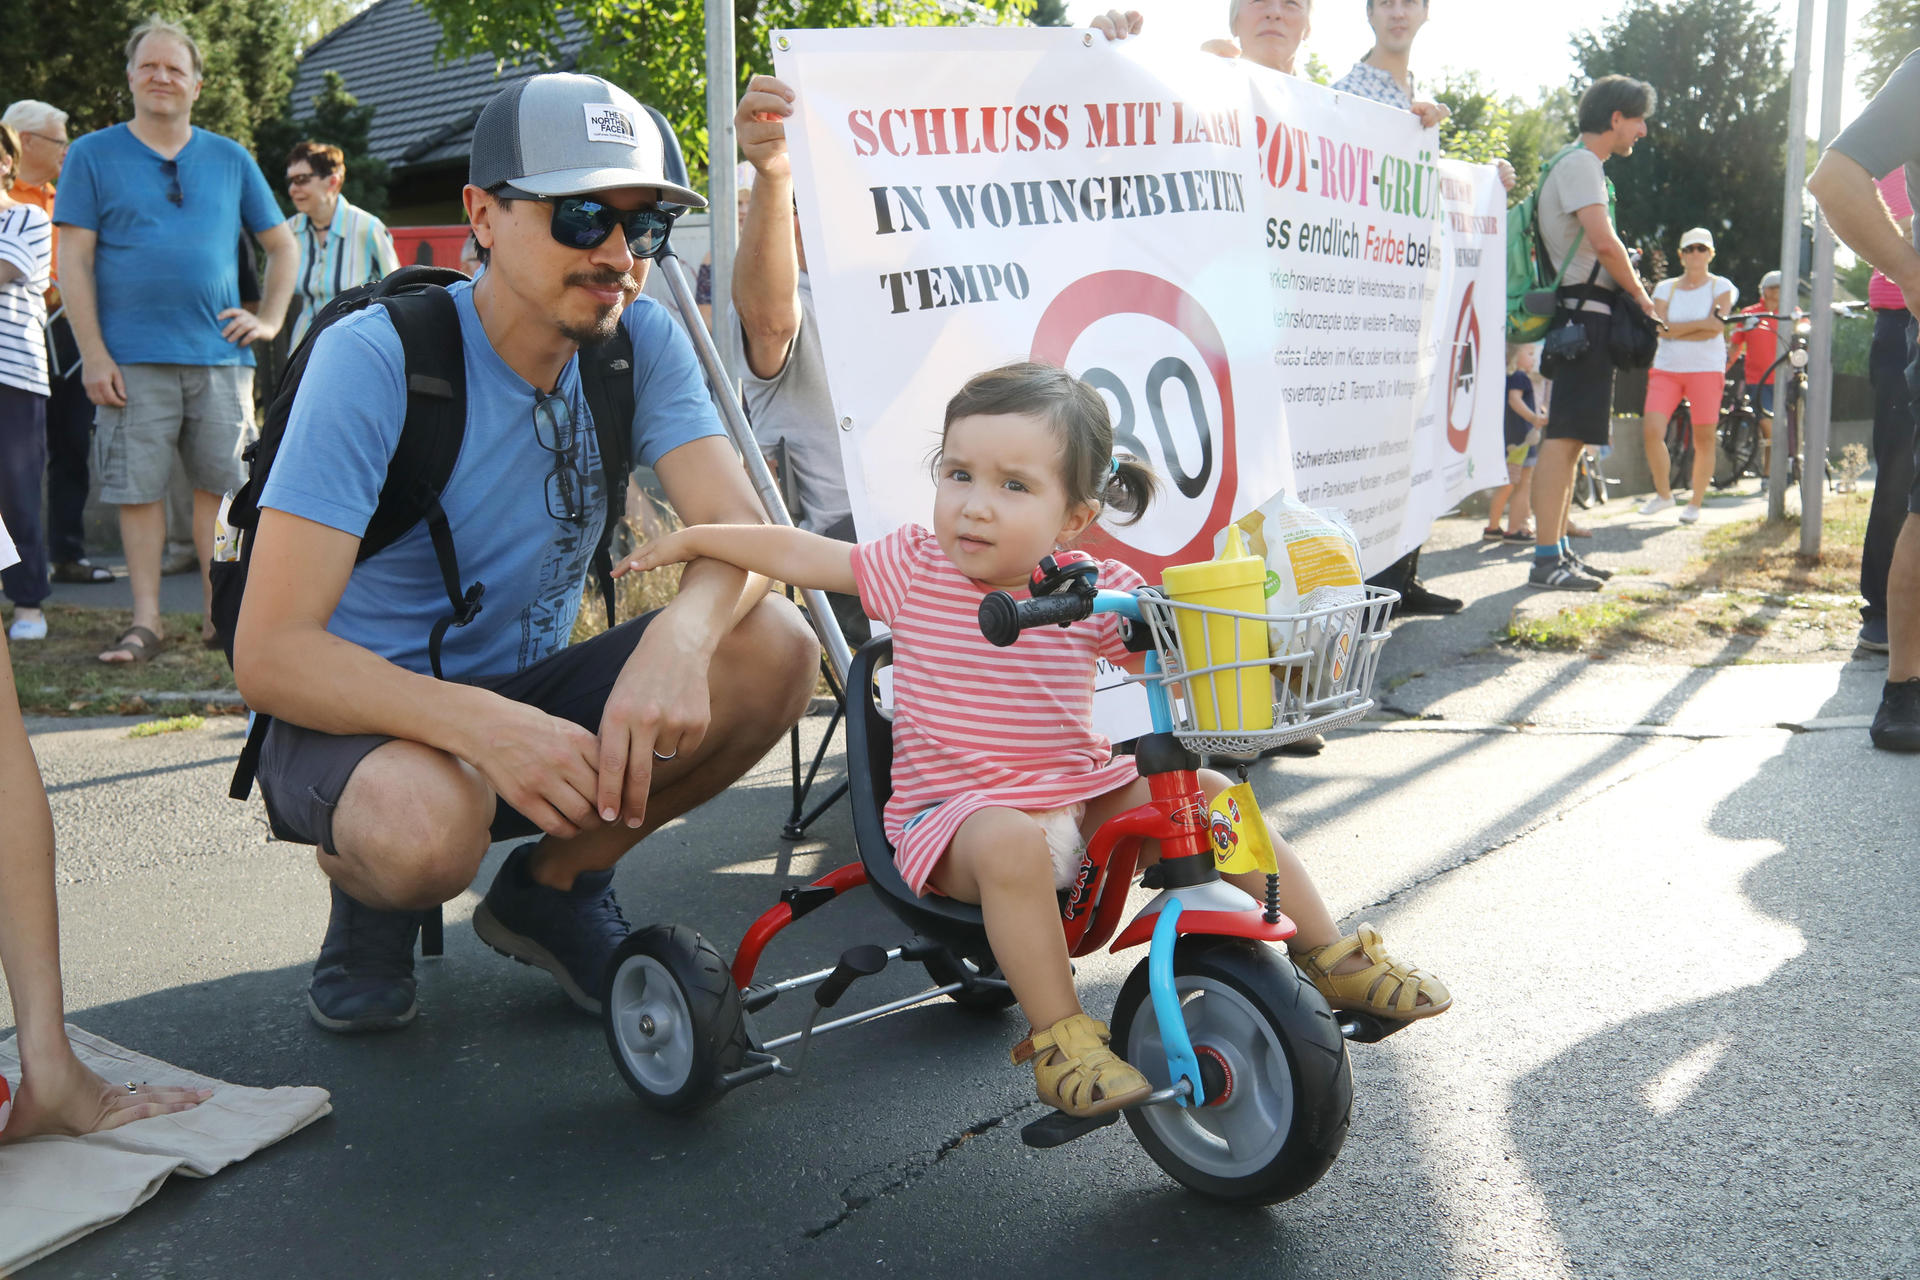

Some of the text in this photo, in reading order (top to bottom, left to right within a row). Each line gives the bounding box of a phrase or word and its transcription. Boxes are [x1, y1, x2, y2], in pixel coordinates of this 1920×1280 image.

[591, 117, 621, 126] NORTH
[603, 110, 620, 119] THE
[601, 125, 622, 133] FACE
[848, 104, 1069, 156] SCHLUSS
[1084, 102, 1161, 148] MIT
[869, 170, 1245, 235] IN WOHNGEBIETEN
[1299, 217, 1359, 259] endlich
[1364, 225, 1404, 264] Farbe
[879, 262, 1030, 314] TEMPO
[1338, 274, 1355, 294] oder
[1343, 313, 1361, 330] oder
[1304, 345, 1333, 366] Leben
[1335, 345, 1346, 366] im
[1348, 345, 1364, 366] Kiez
[1366, 346, 1382, 365] oder
[1351, 380, 1375, 404] Tempo
[1377, 379, 1386, 399] 30
[1296, 445, 1369, 470] Schwerlastverkehr
[1310, 483, 1321, 501] im
[1322, 478, 1358, 498] Pankower
[1064, 851, 1094, 920] PUKY
